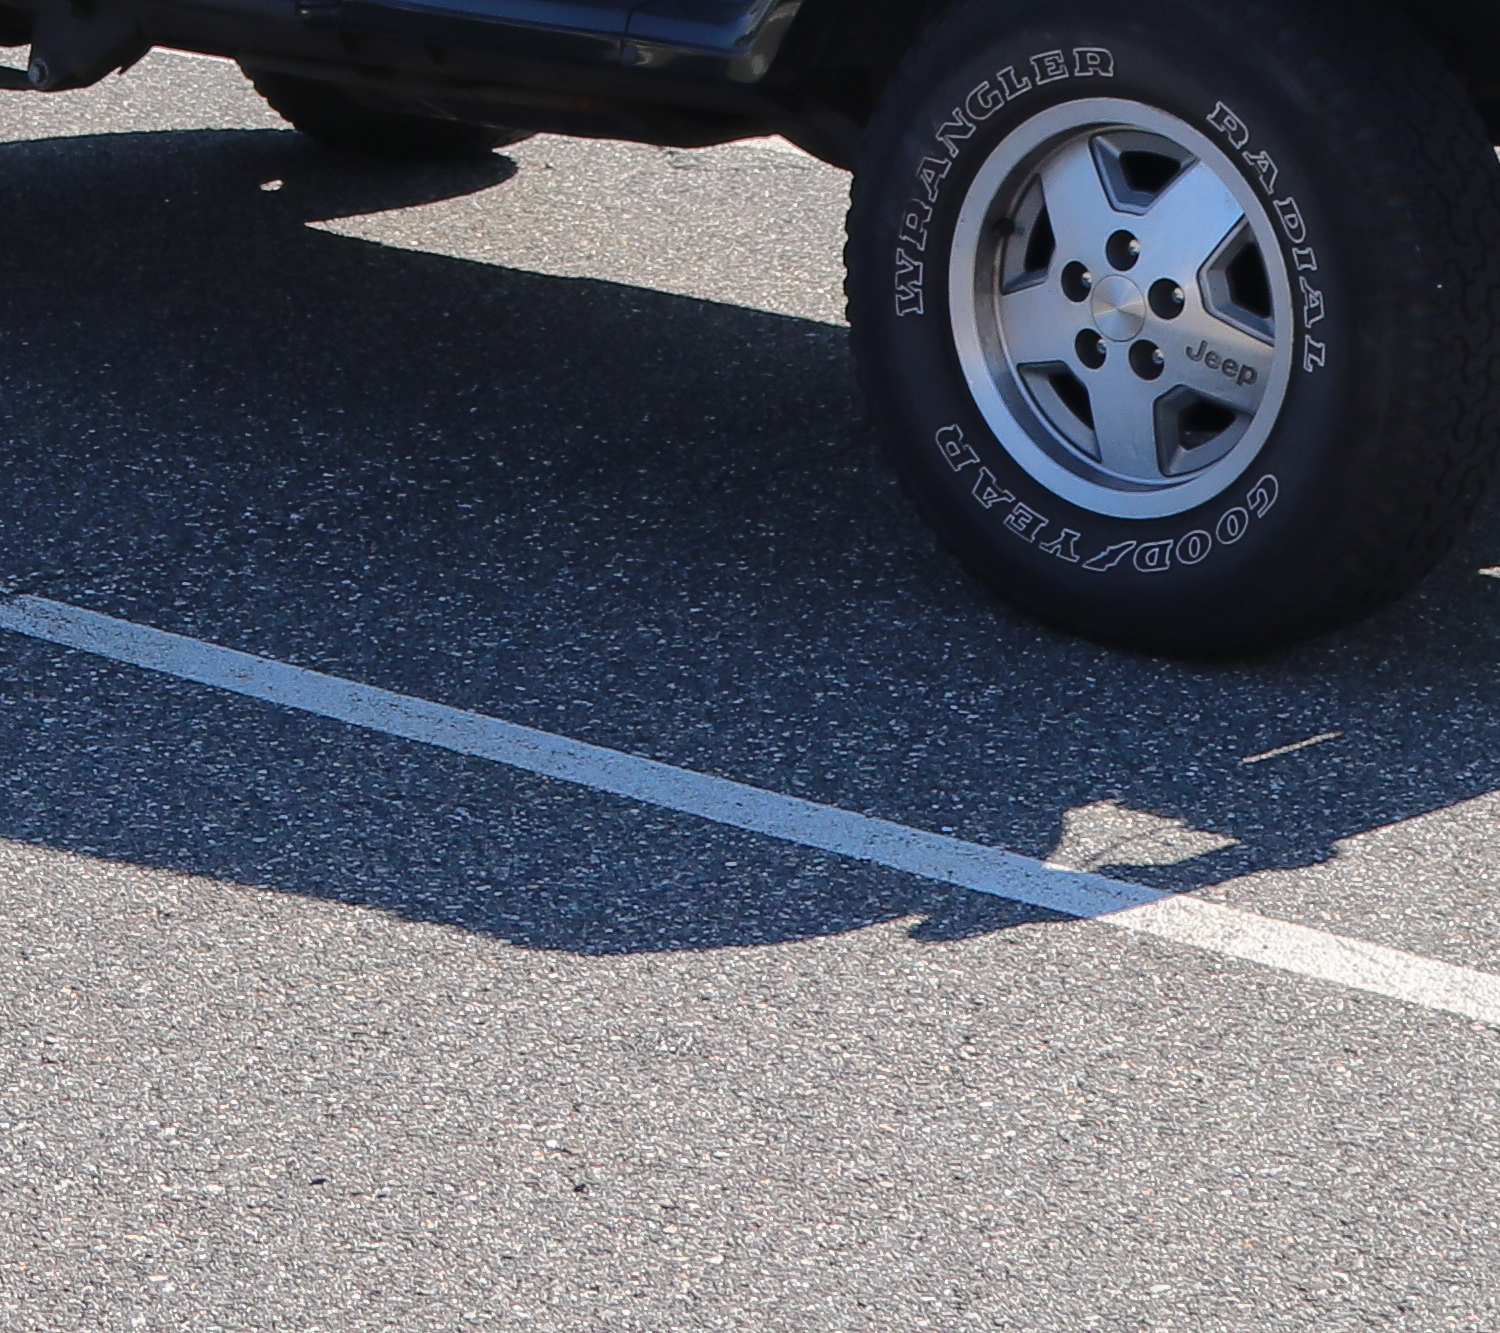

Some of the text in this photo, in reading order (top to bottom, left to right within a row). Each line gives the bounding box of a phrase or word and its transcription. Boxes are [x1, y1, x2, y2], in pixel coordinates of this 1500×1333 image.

[894, 46, 1115, 316] WRANGLER
[1206, 101, 1326, 373] RADIAL
[1185, 339, 1258, 387] Jeep
[935, 423, 1279, 573] GOODYEAR
